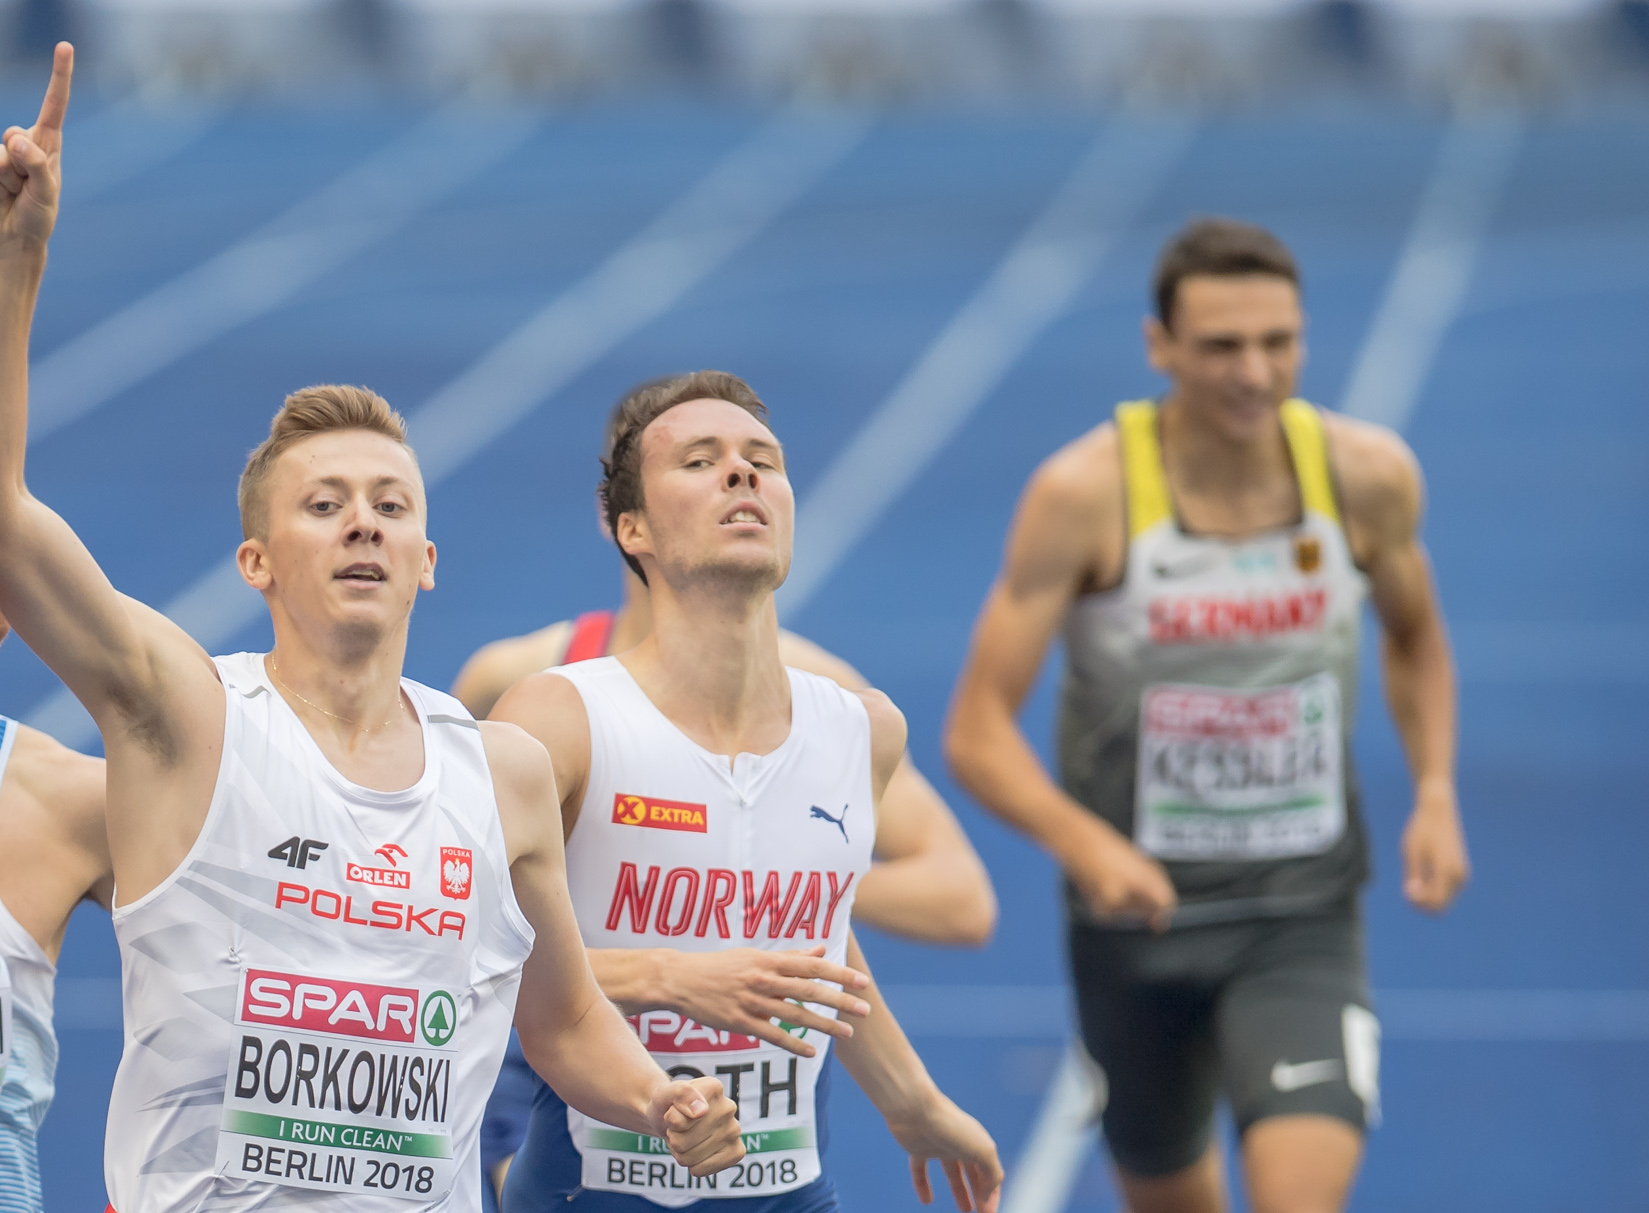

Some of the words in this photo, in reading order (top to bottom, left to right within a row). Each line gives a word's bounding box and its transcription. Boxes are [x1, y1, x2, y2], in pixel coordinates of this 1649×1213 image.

[650, 806, 704, 826] EXTRA
[267, 836, 329, 870] 4F
[442, 848, 471, 859] POLSKA
[349, 866, 407, 887] ORLEN
[275, 882, 466, 941] POLSKA
[605, 861, 854, 940] NORWAY
[248, 978, 415, 1035] SPAR
[234, 1035, 451, 1124] BORKOWSKI
[278, 1121, 285, 1138] I
[291, 1123, 336, 1145] RUN
[241, 1143, 356, 1186] BERLIN
[362, 1159, 435, 1194] 2018
[729, 1159, 798, 1189] 2018
